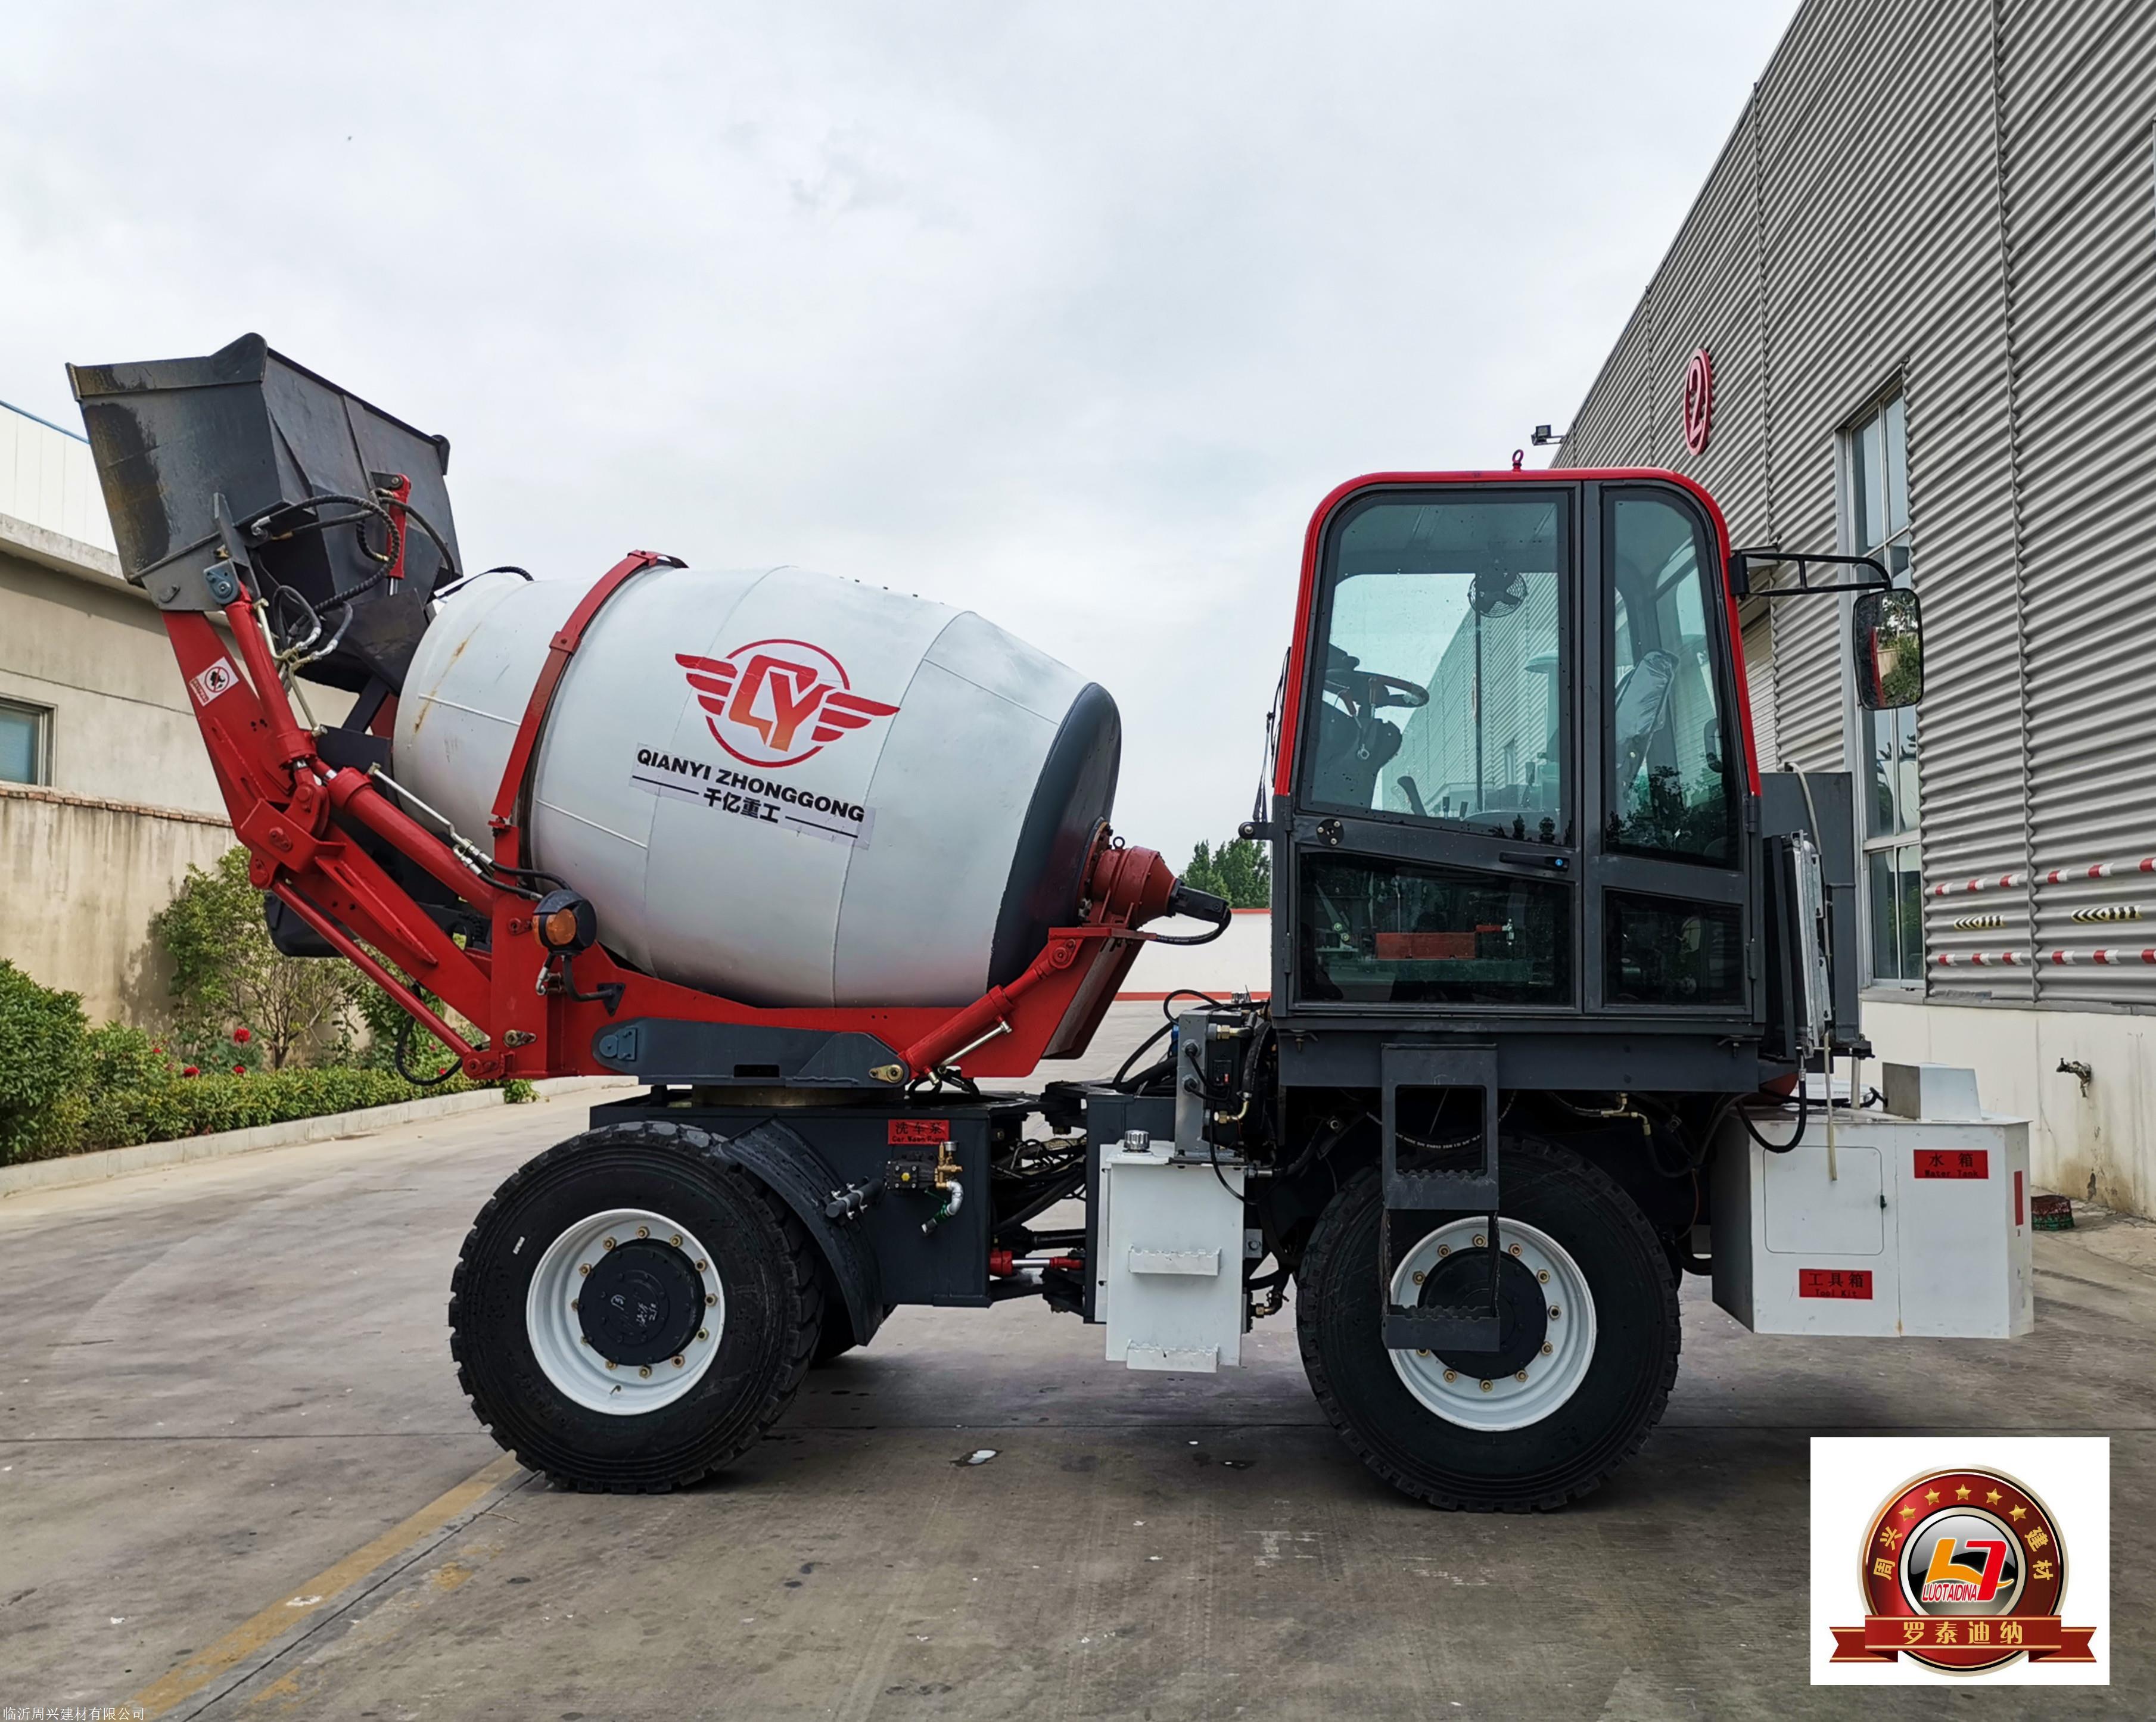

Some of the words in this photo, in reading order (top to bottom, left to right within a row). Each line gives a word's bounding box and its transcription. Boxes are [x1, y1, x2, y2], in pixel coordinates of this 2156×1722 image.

[637, 749, 711, 780] QIANYI
[715, 769, 865, 823] ZHONGGONG
[703, 787, 781, 824] 千亿重工
[895, 1122, 942, 1135] 洗车泵
[1928, 1153, 1974, 1168] 水箱
[1925, 1169, 1950, 1178] Water
[1956, 1169, 1978, 1178] Tank
[1808, 1272, 1864, 1288] 工具箱
